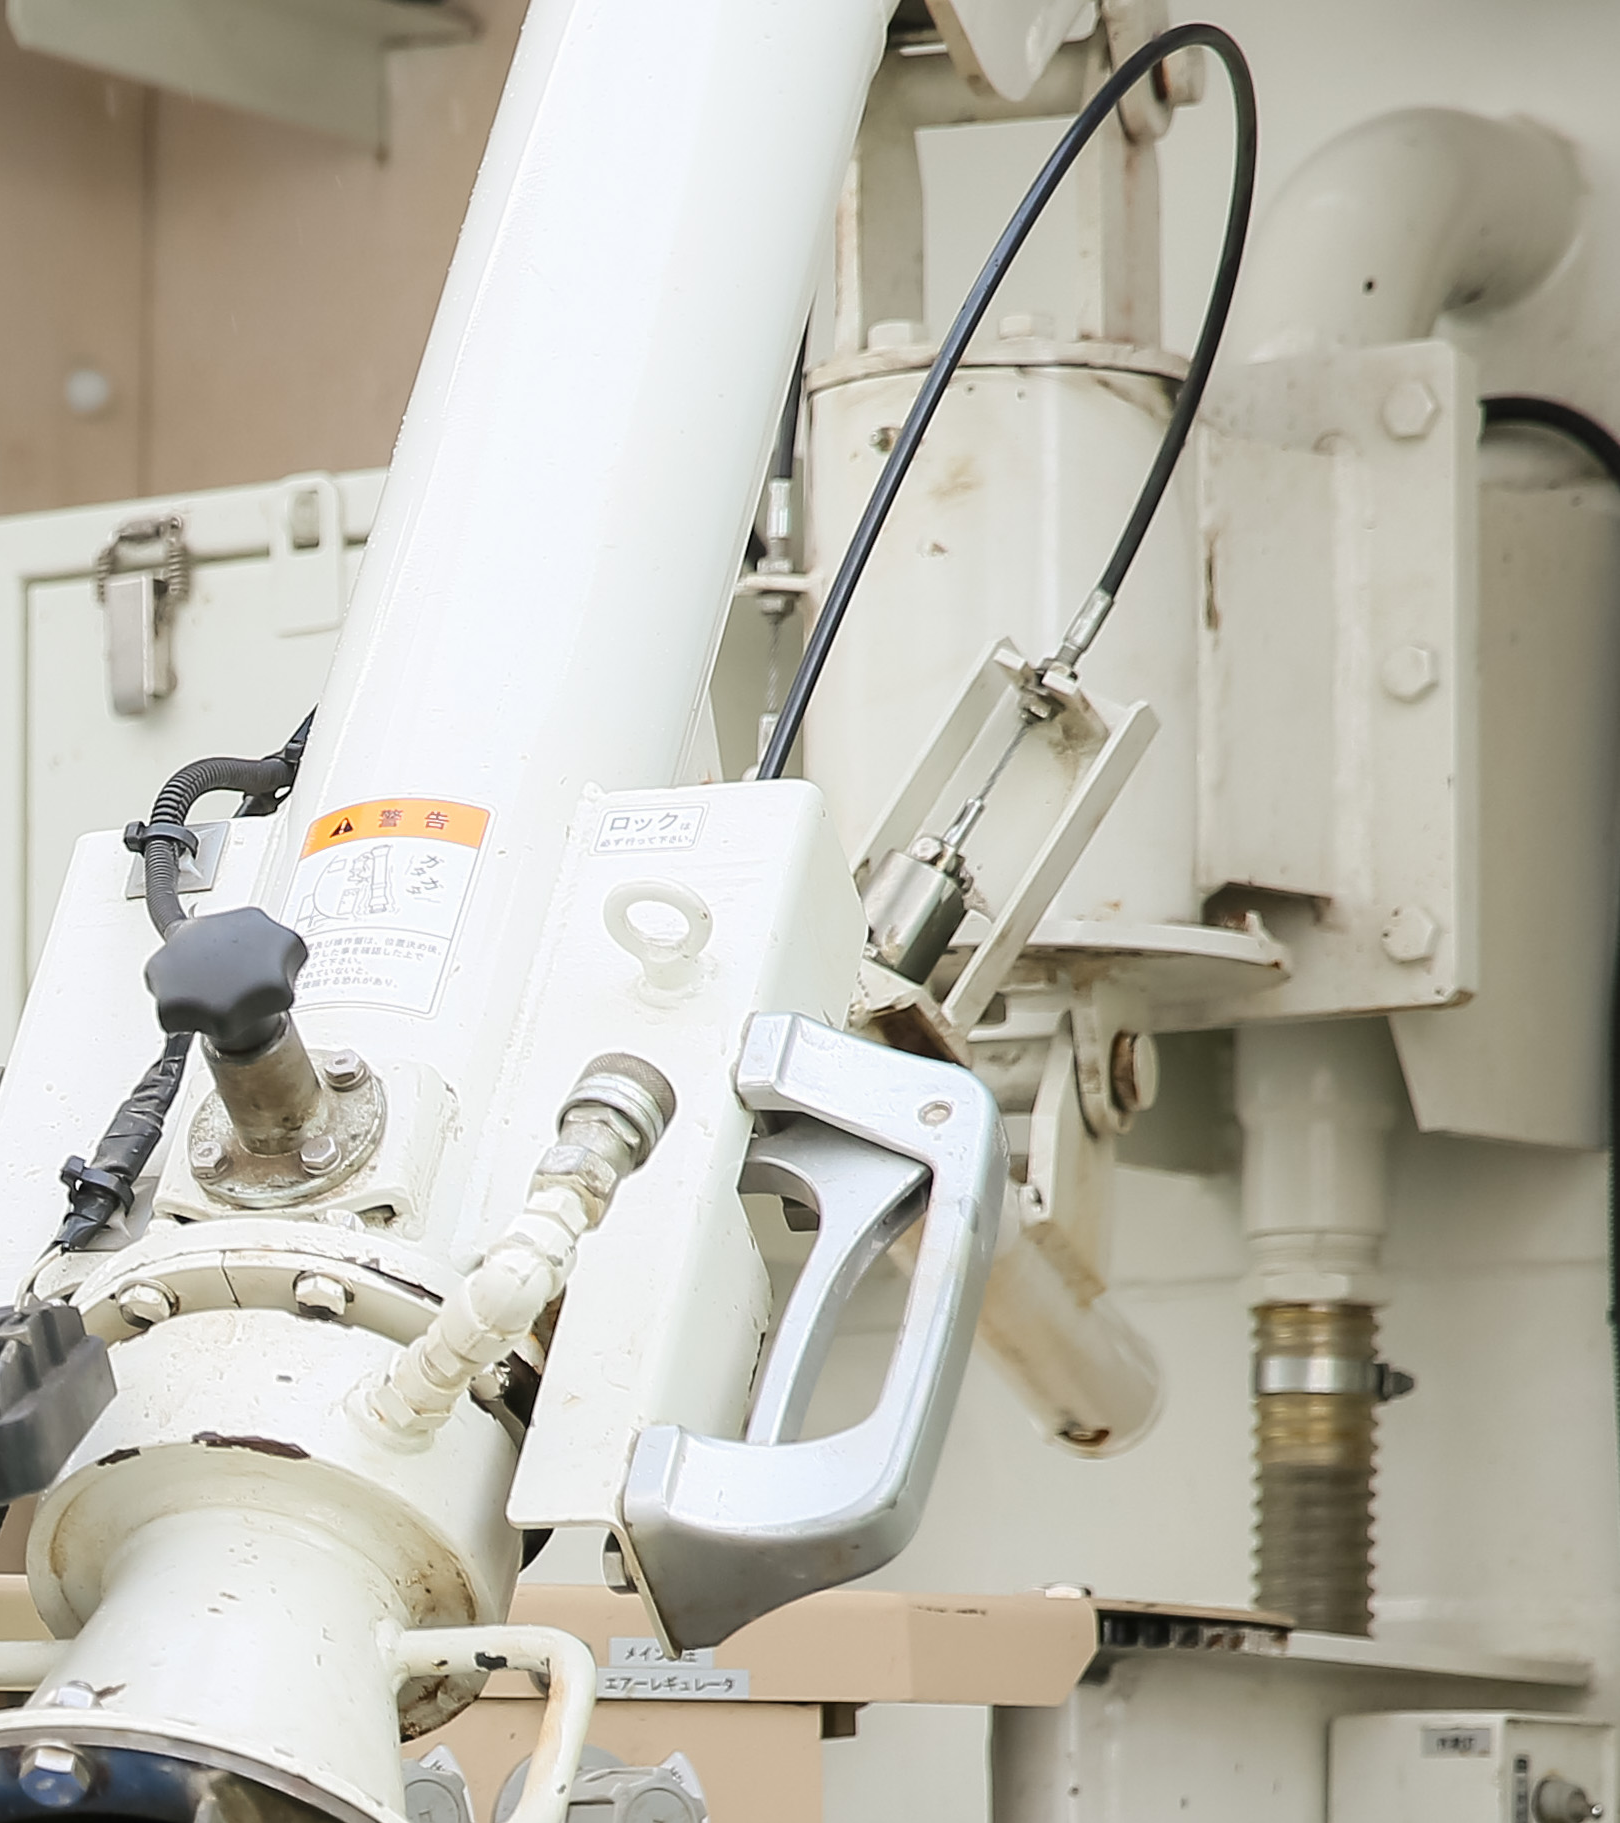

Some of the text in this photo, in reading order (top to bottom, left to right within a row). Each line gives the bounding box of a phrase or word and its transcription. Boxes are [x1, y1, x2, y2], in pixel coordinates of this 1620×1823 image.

[378, 808, 450, 830] 警告
[604, 1676, 736, 1692] エアーレギュレータ
